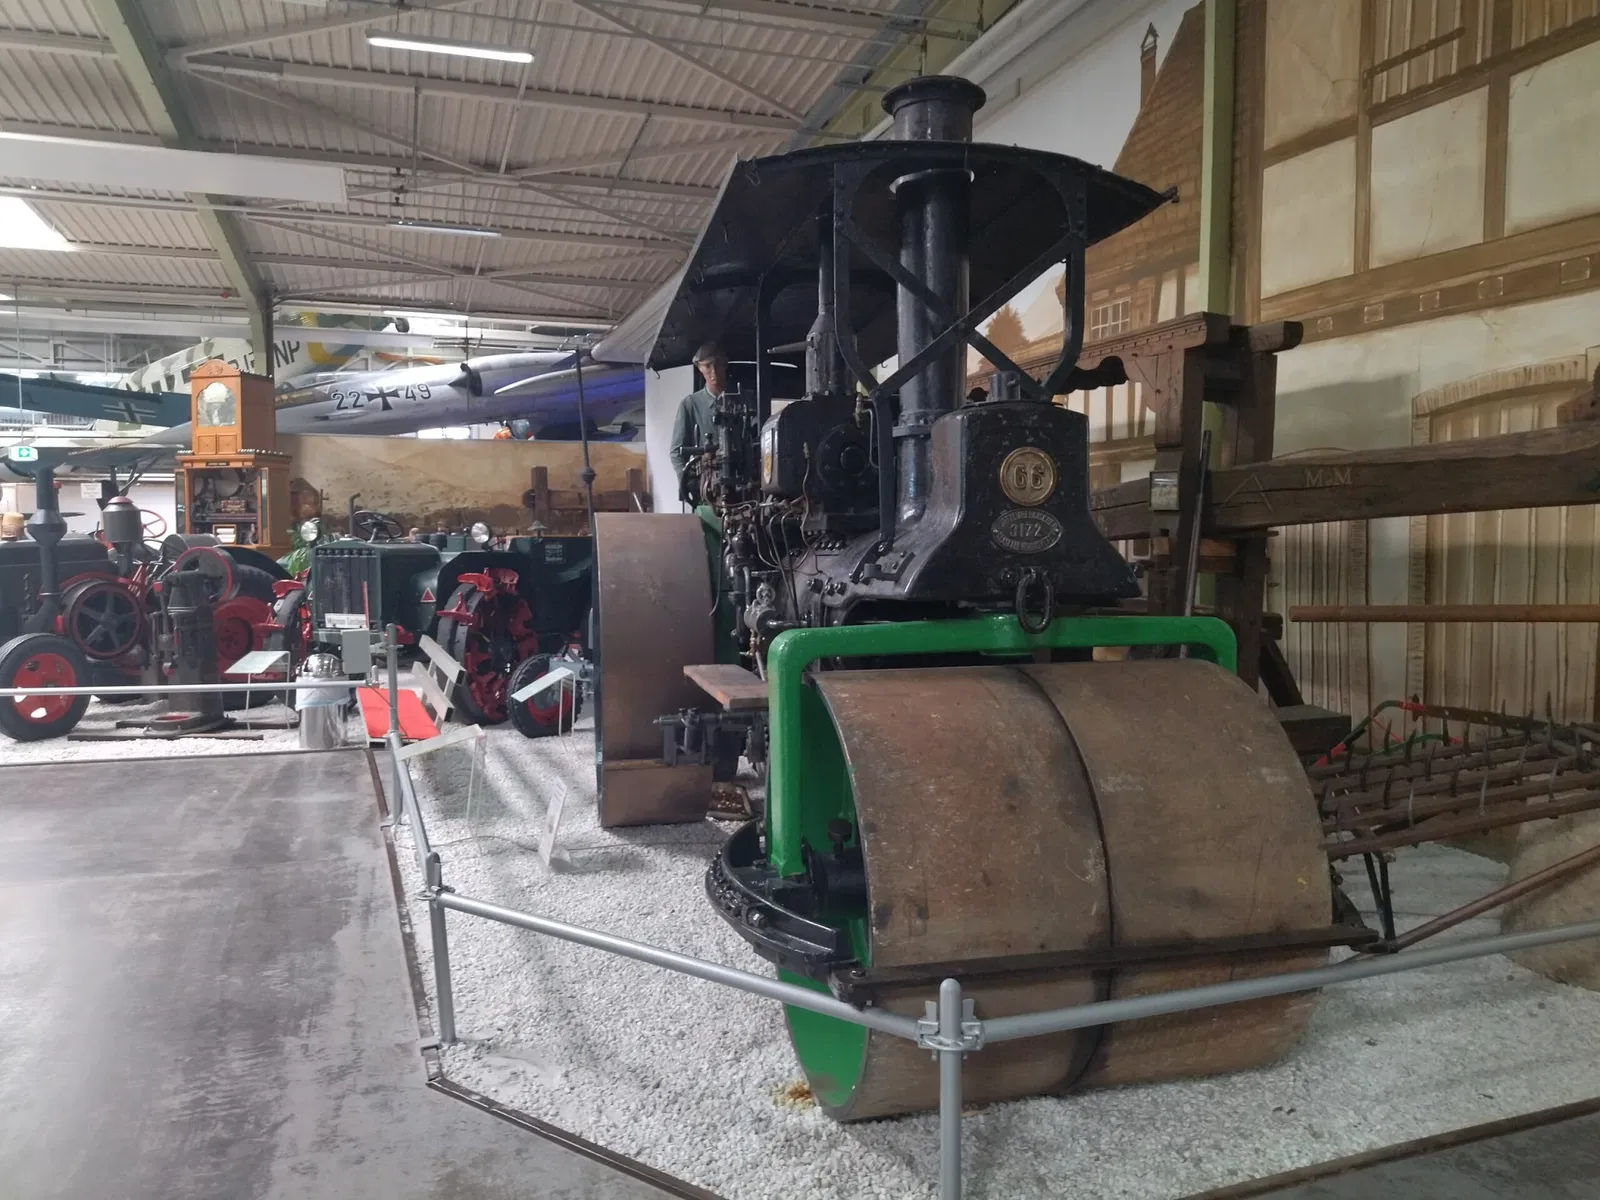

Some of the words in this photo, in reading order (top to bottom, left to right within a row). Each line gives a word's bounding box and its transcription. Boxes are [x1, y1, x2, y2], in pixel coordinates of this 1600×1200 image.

[331, 390, 364, 410] 22
[405, 384, 431, 401] 49
[1013, 464, 1044, 489] 66
[1009, 522, 1043, 538] 3172
